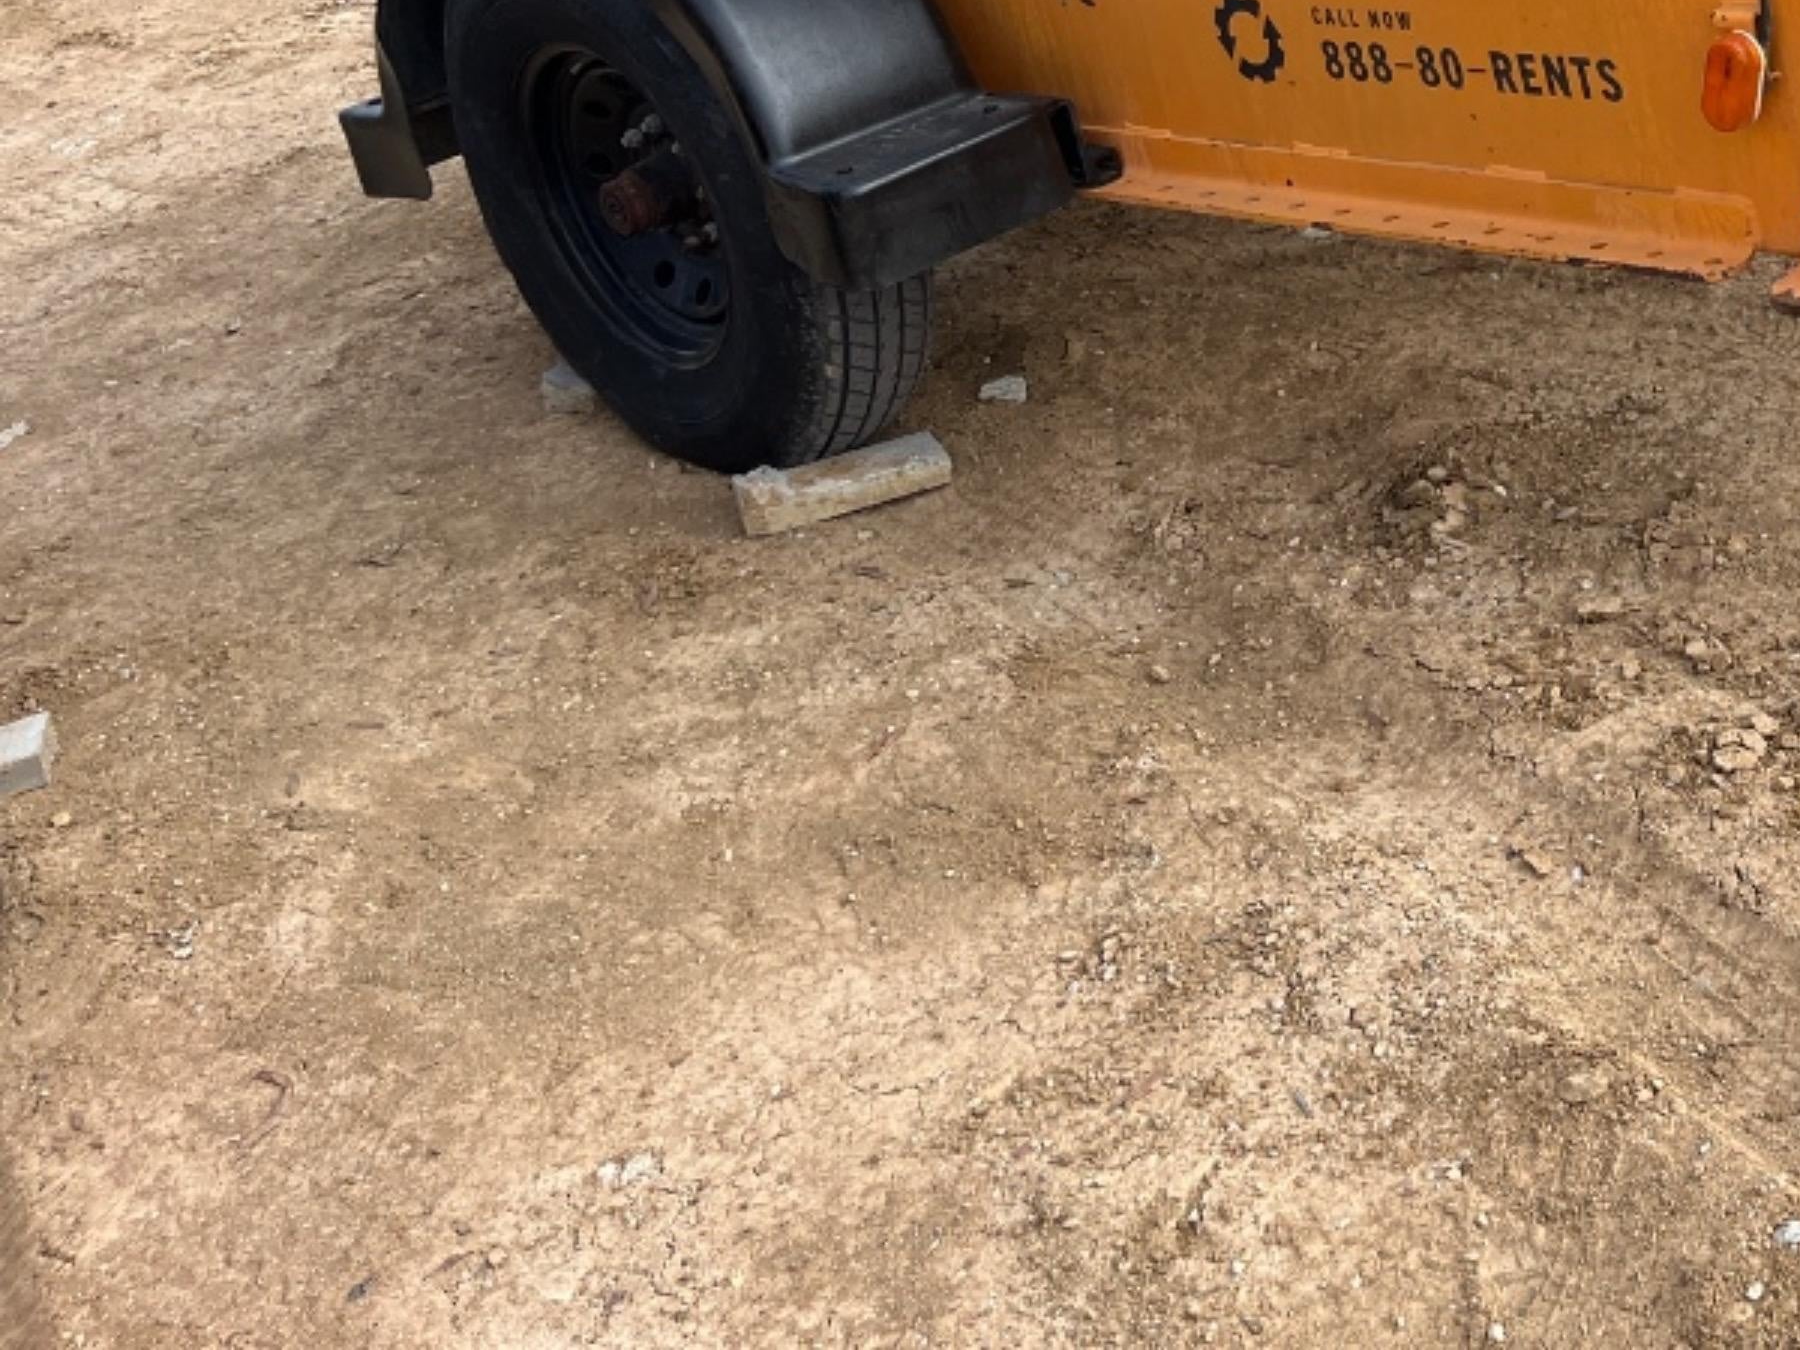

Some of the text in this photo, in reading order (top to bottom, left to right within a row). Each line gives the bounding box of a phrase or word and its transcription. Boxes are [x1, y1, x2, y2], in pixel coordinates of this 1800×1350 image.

[1310, 5, 1411, 31] CALL NOW
[1321, 38, 1625, 103] 888-80-RENTS
